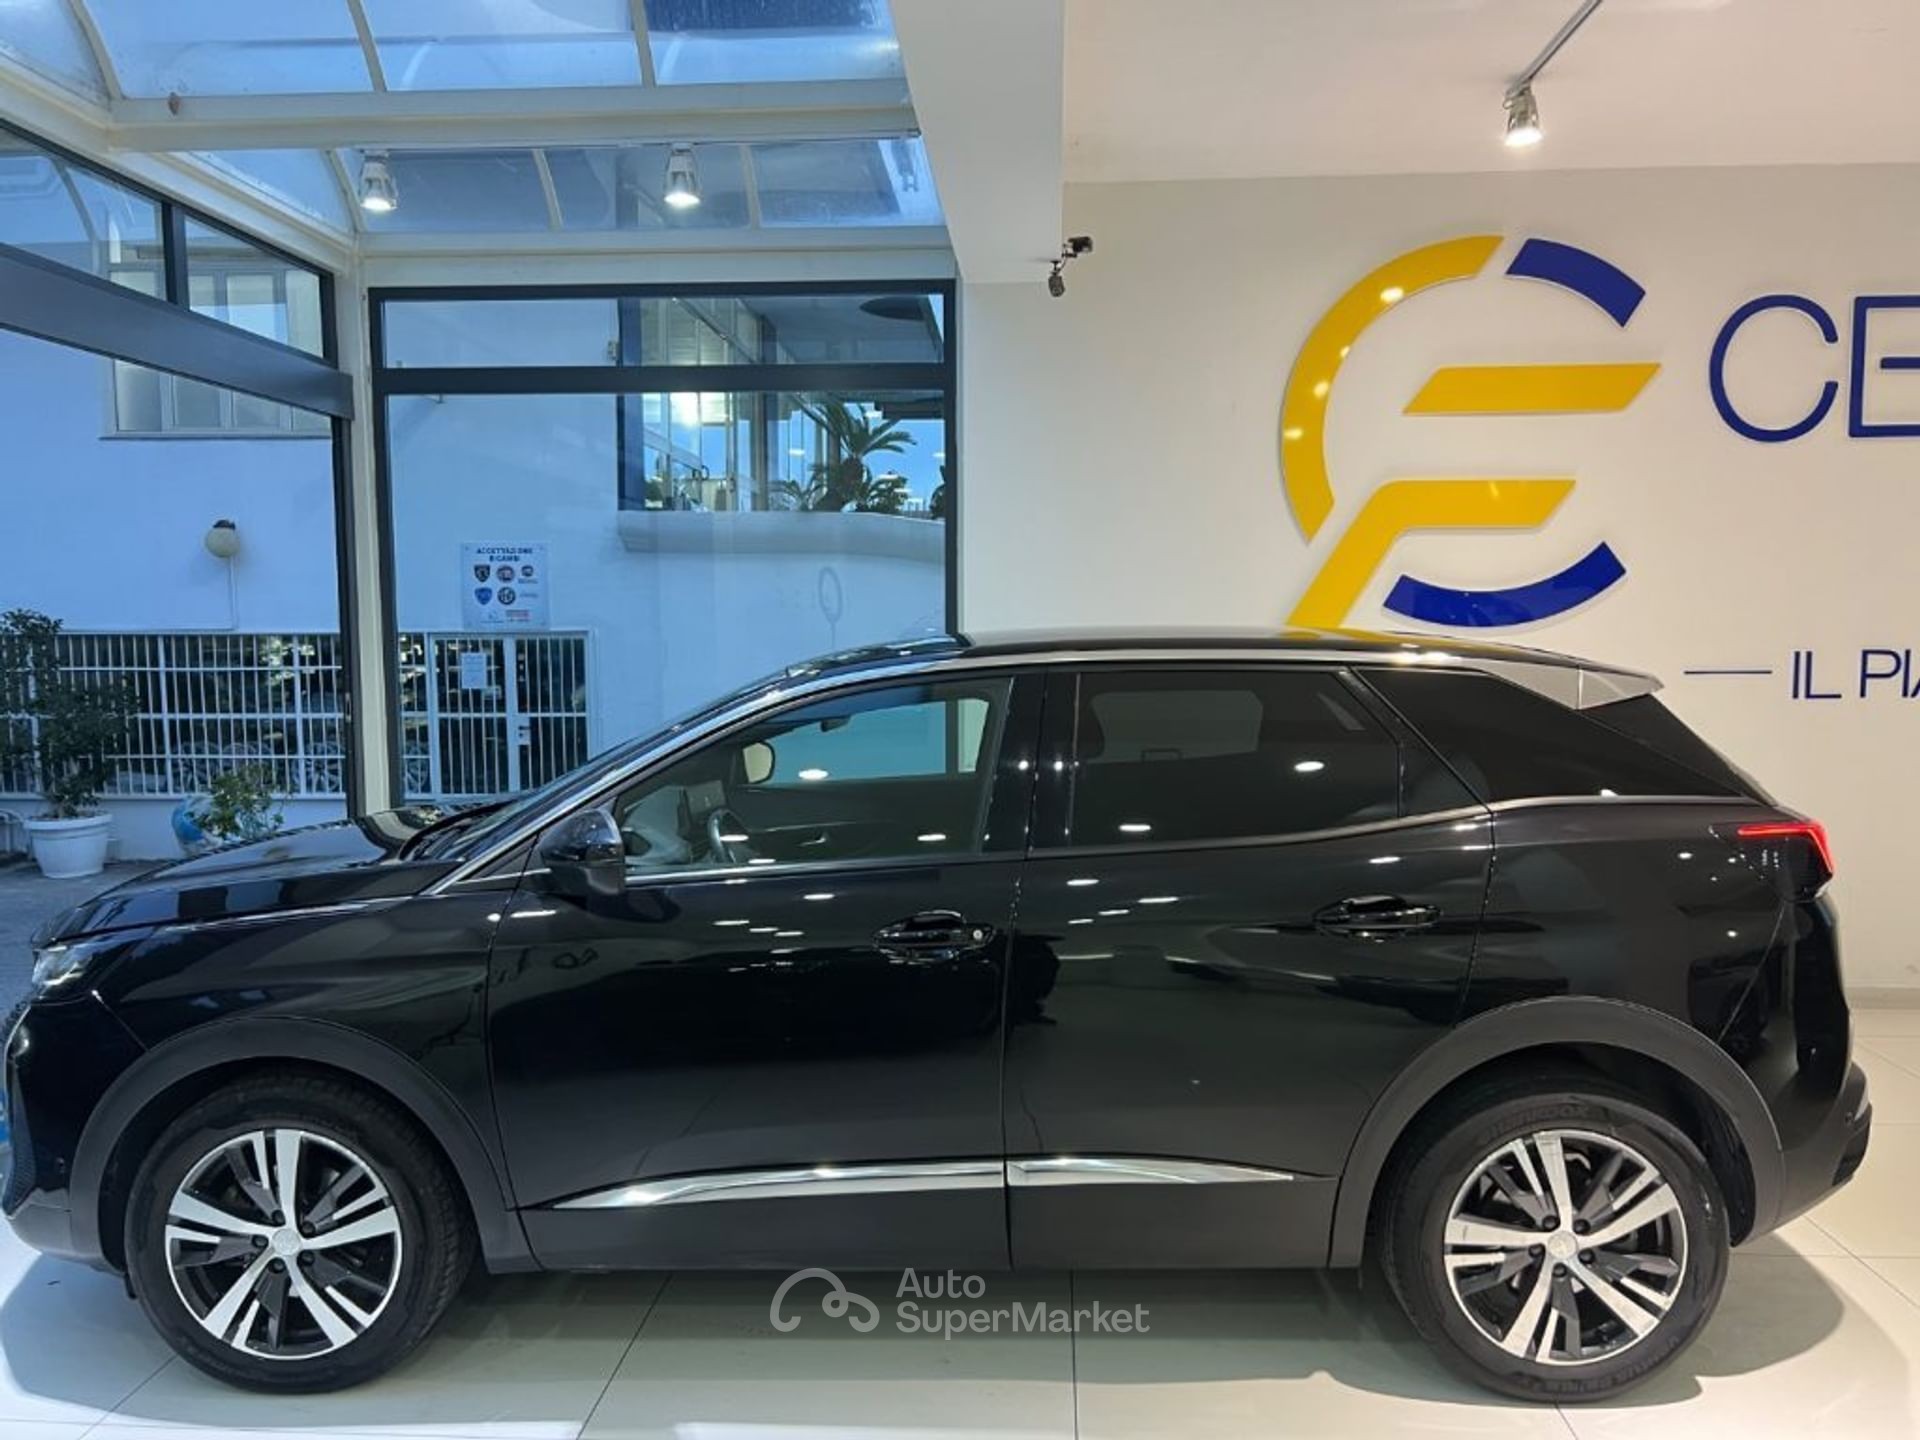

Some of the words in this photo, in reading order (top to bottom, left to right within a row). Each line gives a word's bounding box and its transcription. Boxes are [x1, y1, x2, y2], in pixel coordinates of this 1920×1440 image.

[1709, 294, 1920, 442] CE
[1792, 650, 1843, 700] IL
[1860, 649, 1920, 698] PI
